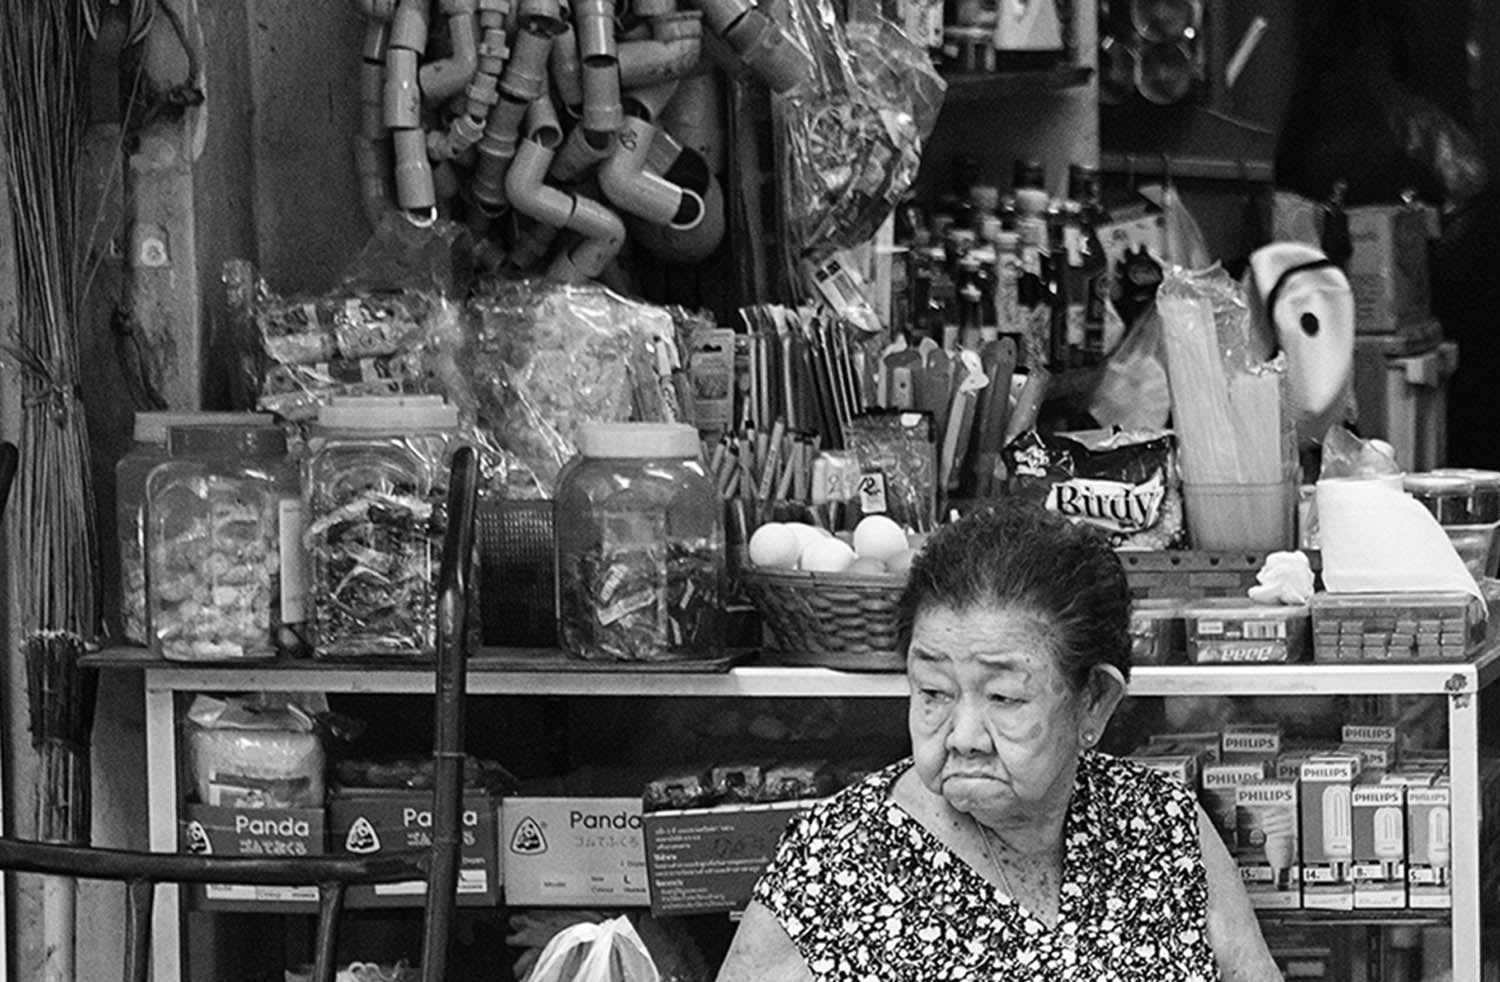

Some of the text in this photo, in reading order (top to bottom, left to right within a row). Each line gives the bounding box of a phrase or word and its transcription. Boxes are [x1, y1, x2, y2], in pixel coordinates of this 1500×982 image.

[1056, 485, 1158, 530] Birdy
[1345, 728, 1392, 739] PHILIPS
[1225, 738, 1275, 750] PHILIPS
[1304, 766, 1348, 777] PHILIPS
[1238, 790, 1293, 802] PHILIPS
[1354, 791, 1399, 802] PHILIPS
[1409, 792, 1447, 802] PHILIPS
[403, 807, 478, 828] Paa
[570, 810, 643, 830] Panda
[236, 814, 309, 836] Panda
